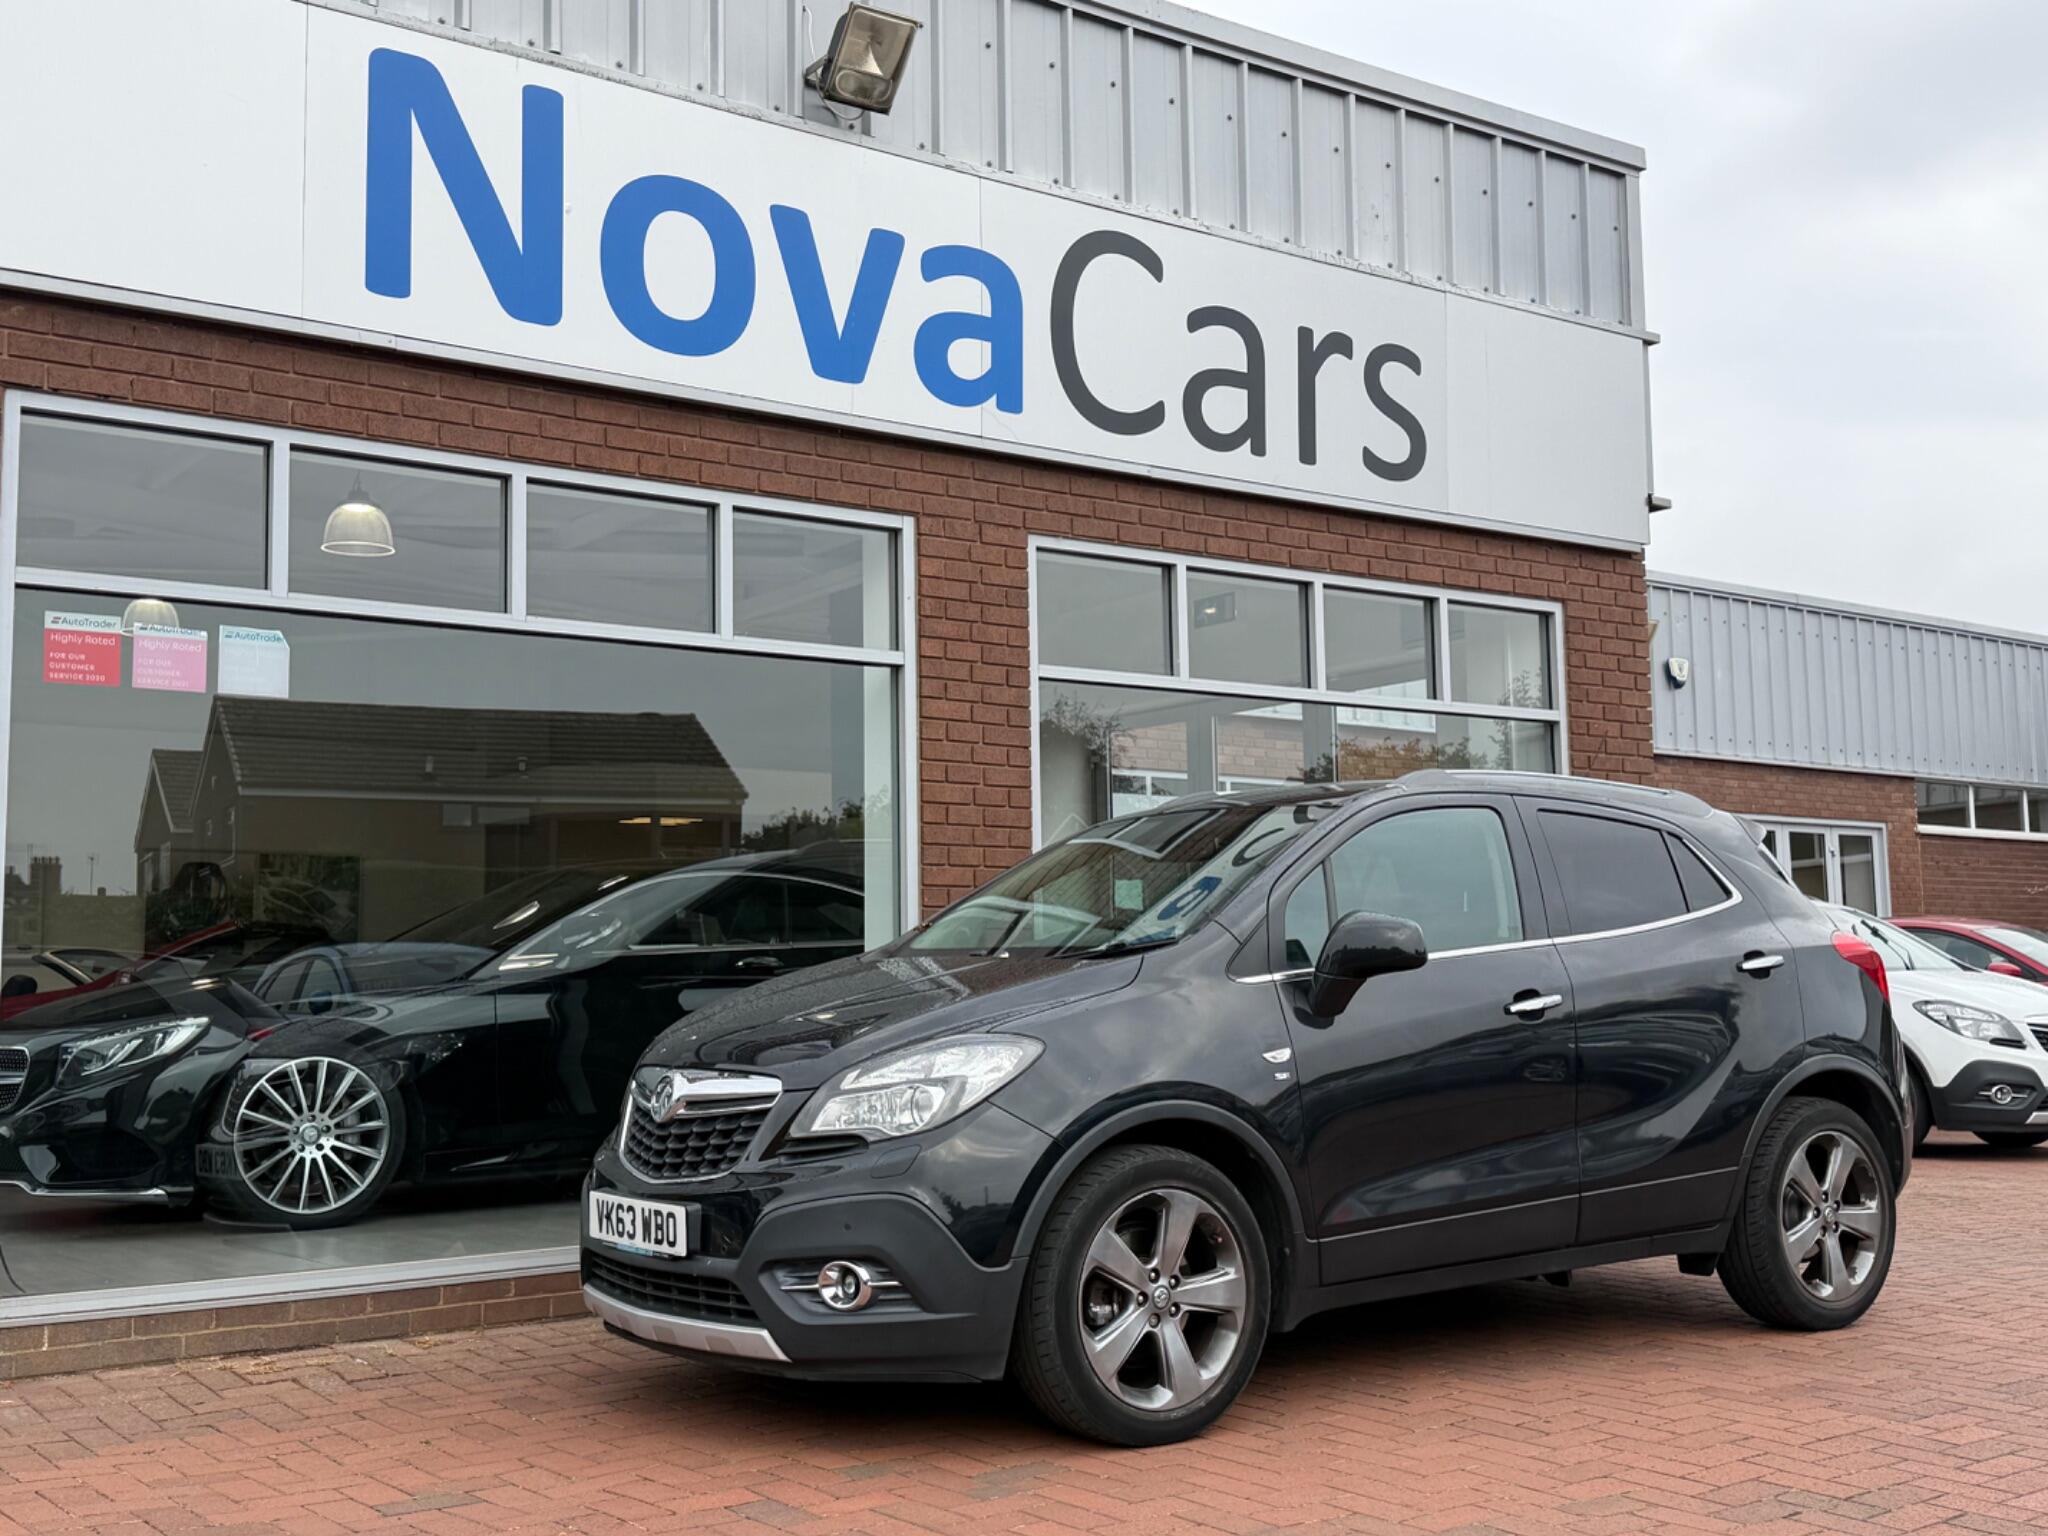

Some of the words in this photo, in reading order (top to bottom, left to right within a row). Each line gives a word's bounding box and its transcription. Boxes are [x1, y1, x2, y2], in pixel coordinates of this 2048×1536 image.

[61, 617, 117, 628] AutoTrader
[50, 632, 83, 645] Highly
[85, 635, 116, 646] Rated
[233, 631, 284, 643] AutoTrade
[138, 639, 171, 651] Highly
[172, 642, 202, 653] Rated
[49, 651, 66, 660] FOR
[68, 652, 86, 661] OUR
[49, 661, 95, 671] CUSTOMER
[49, 672, 84, 681] SERVICE
[596, 1198, 637, 1240] VK63
[641, 1207, 677, 1248] WBO
